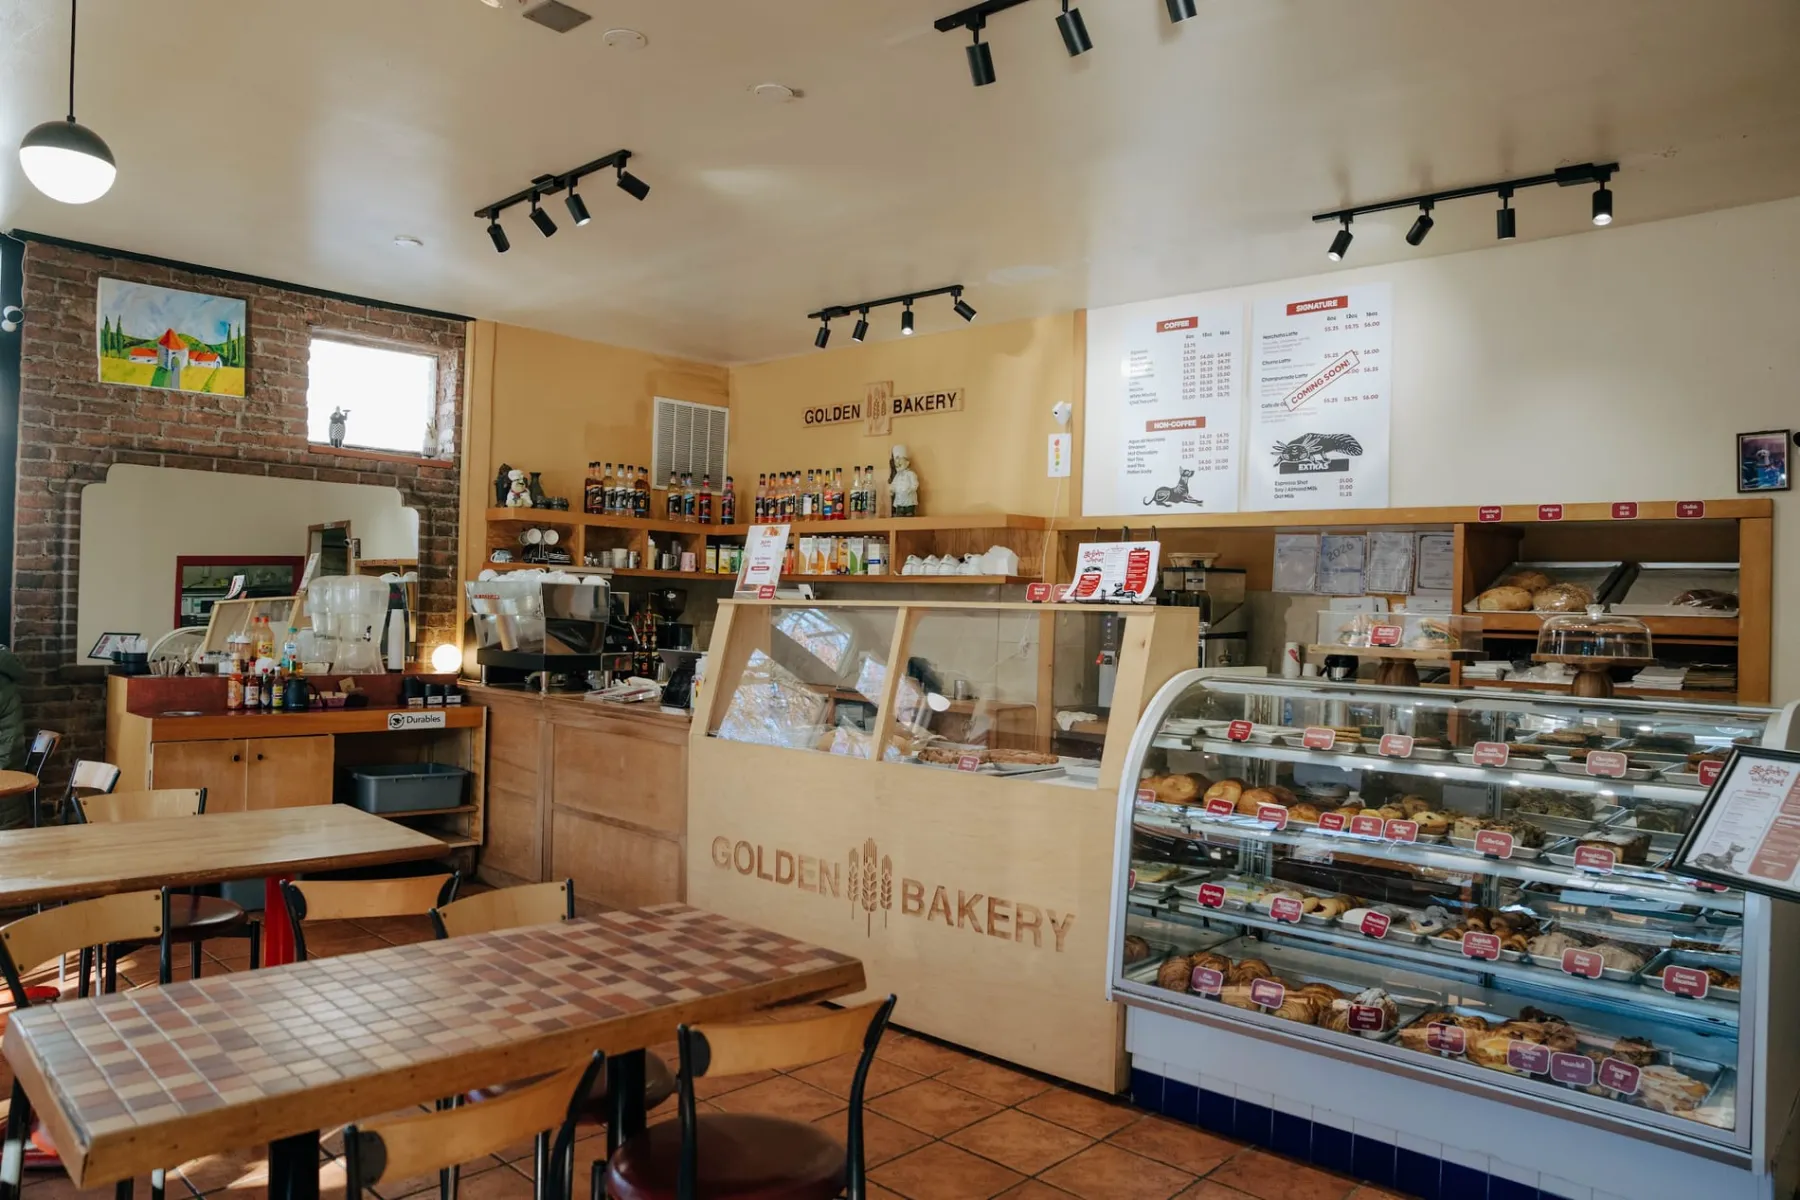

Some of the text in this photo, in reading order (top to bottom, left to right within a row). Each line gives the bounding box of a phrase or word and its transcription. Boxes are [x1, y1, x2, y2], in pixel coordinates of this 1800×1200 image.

[1296, 299, 1338, 312] SIGNATURE
[1164, 320, 1190, 330] COFFEE
[1292, 378, 1323, 404] COMING
[1324, 359, 1350, 381] SOON!
[804, 392, 957, 424] GOLDEN BAKERY
[1154, 420, 1196, 429] NON-COFFEE
[1327, 542, 1354, 562] 2026
[406, 715, 441, 724] Durables
[712, 835, 1076, 952] GOLDEN BAKERY
